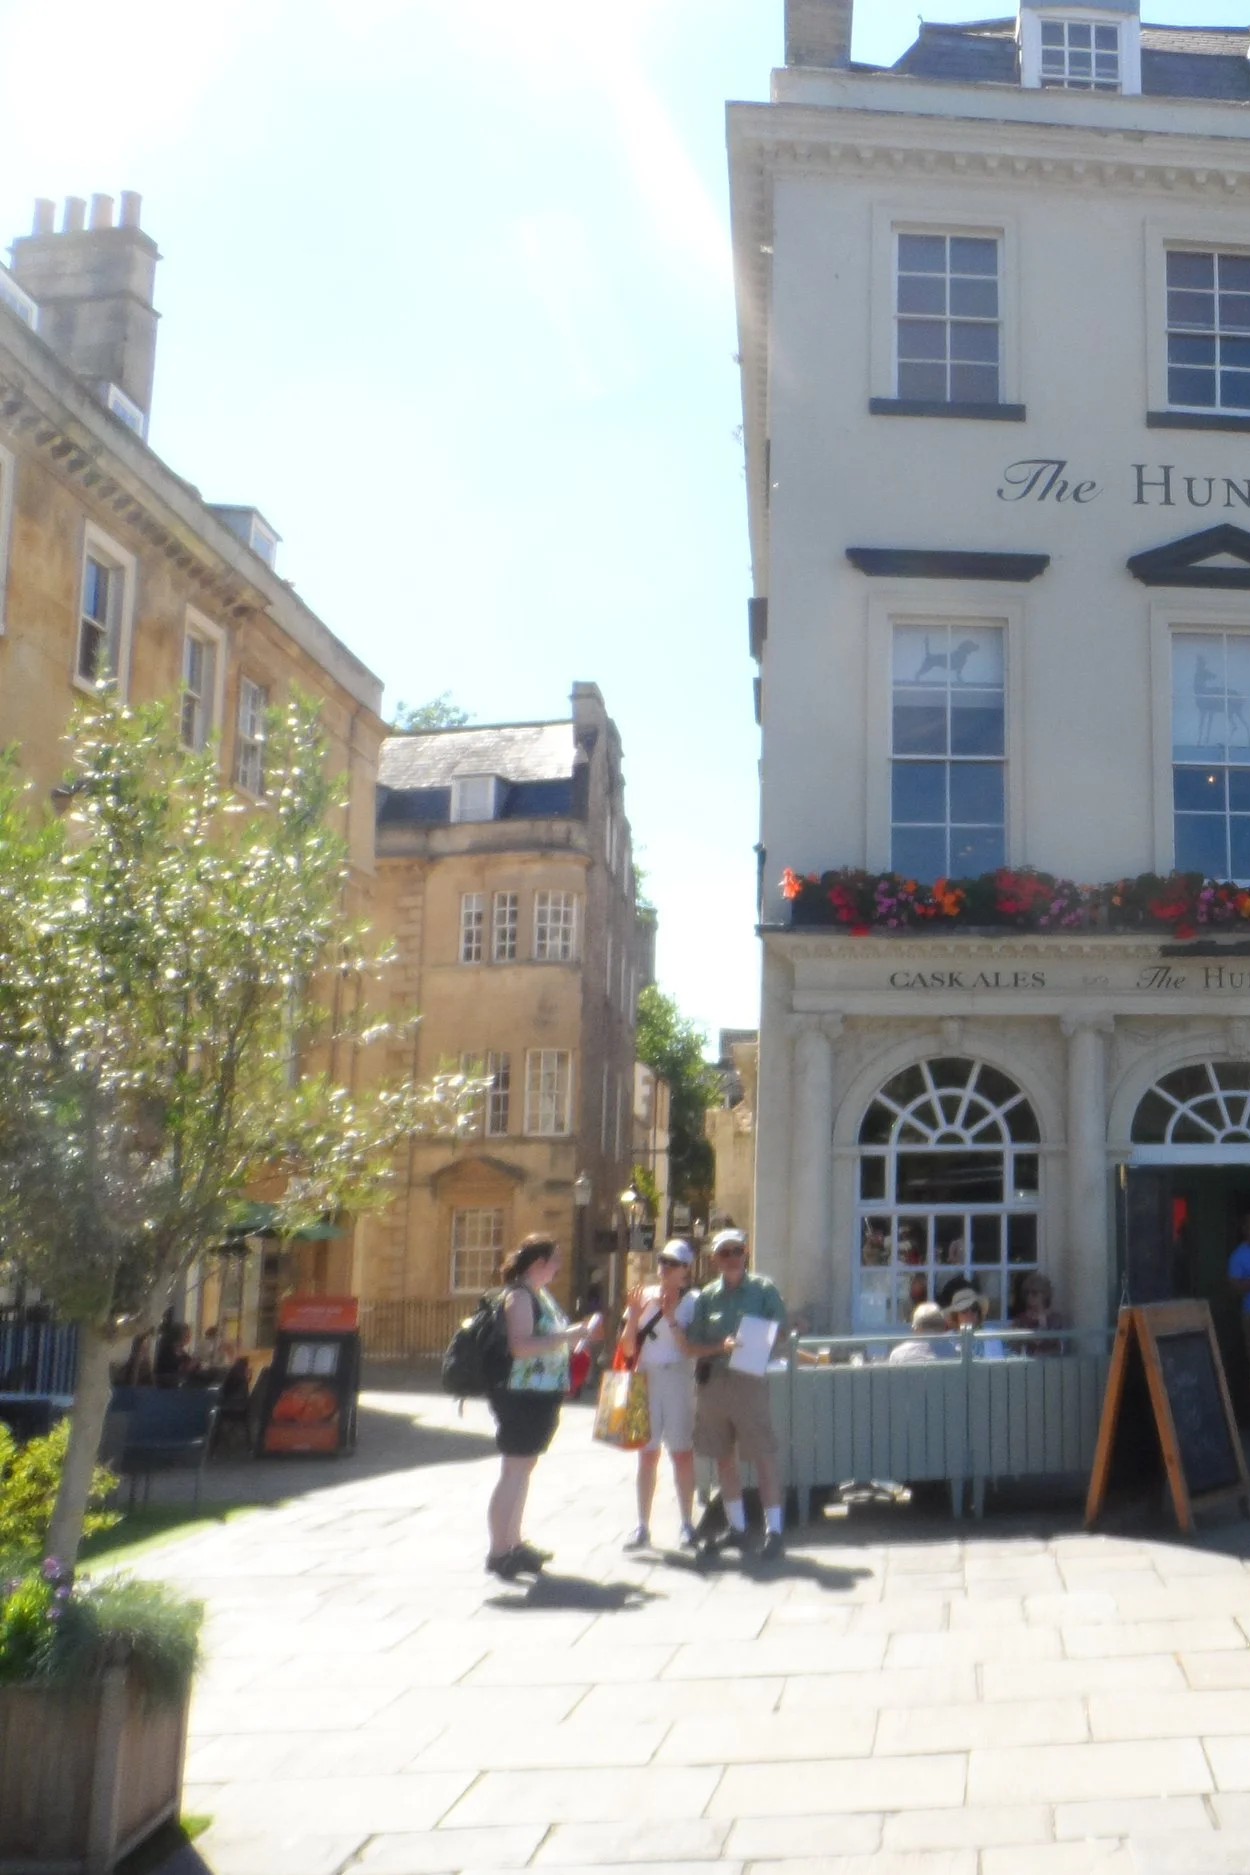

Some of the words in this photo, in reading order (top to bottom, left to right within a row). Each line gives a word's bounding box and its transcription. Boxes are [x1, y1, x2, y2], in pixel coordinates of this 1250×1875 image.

[997, 459, 1101, 503] The
[889, 971, 964, 989] CASK
[971, 971, 1046, 989] ALES
[1136, 966, 1186, 990] The
